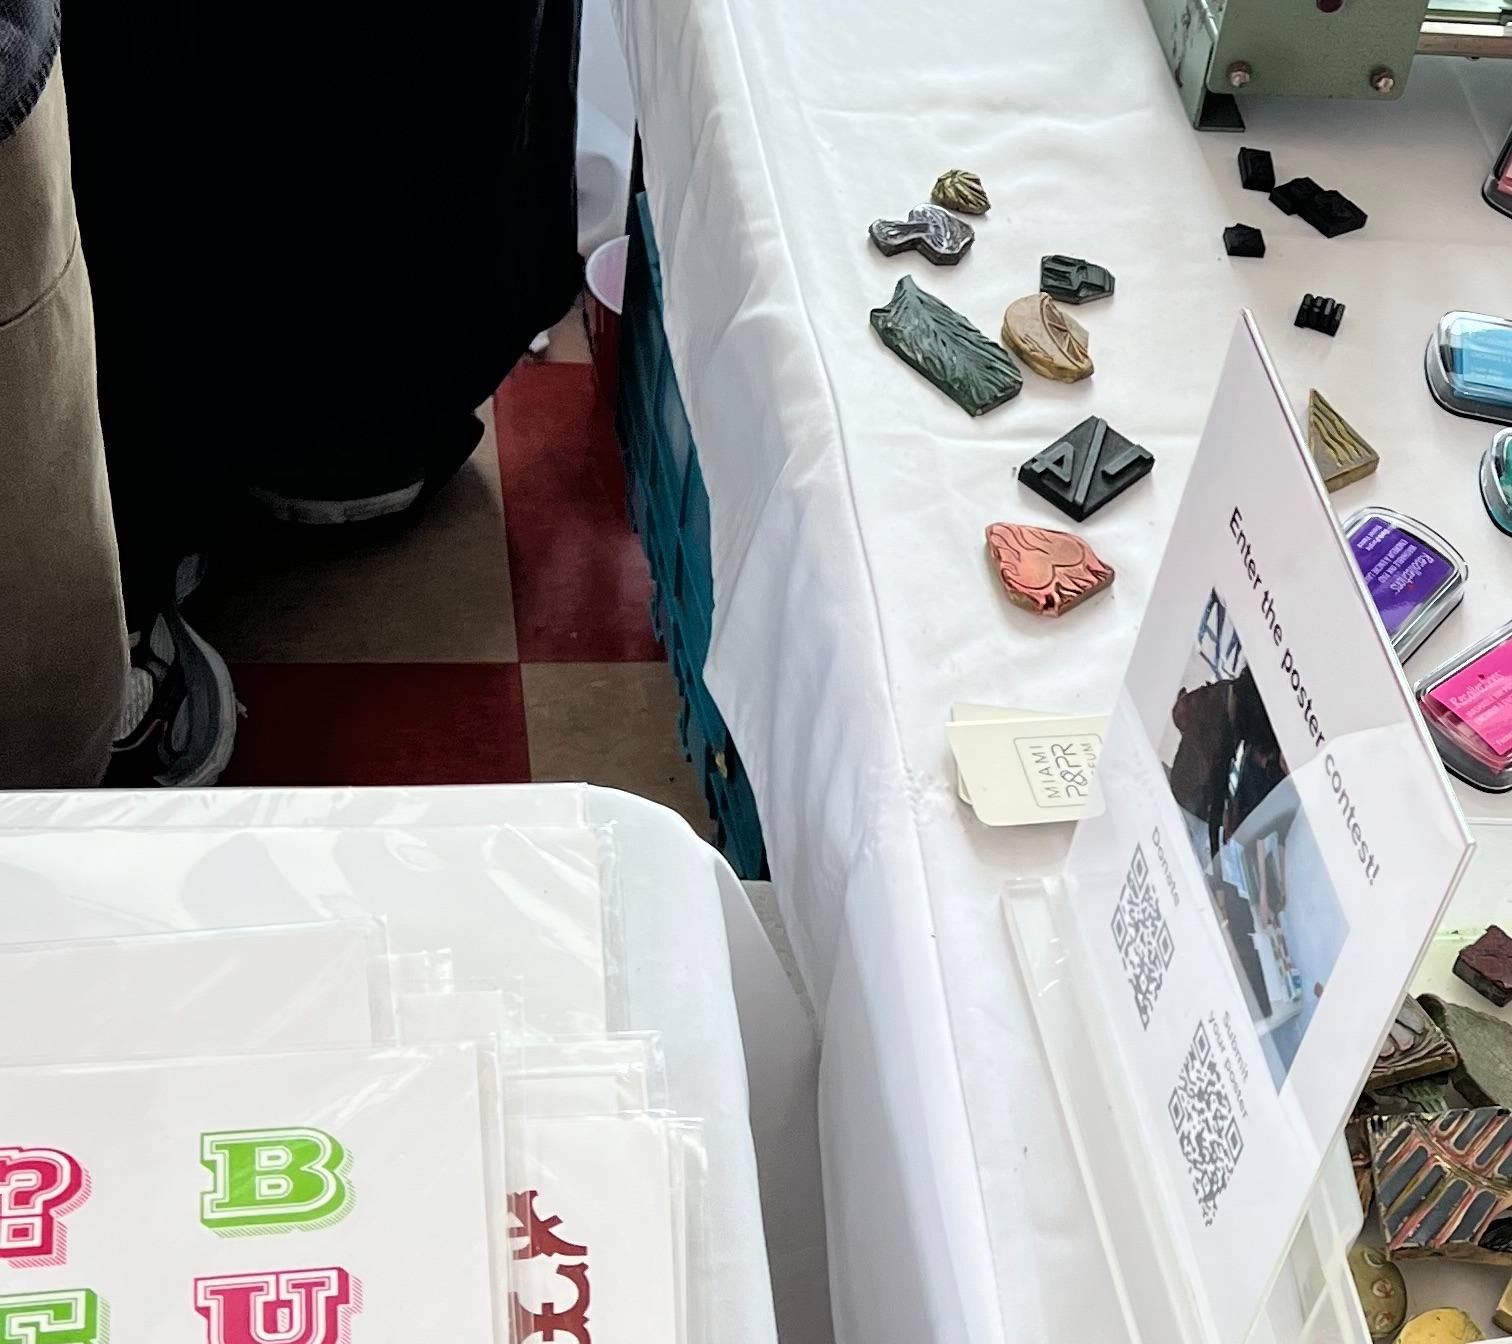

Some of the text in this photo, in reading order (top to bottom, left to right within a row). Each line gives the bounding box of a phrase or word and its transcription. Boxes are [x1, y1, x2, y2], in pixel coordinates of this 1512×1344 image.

[1389, 552, 1434, 594] Recollections
[1230, 507, 1383, 886] Enter the poster contest!
[1449, 670, 1504, 709] Recollections
[1029, 745, 1061, 798] MIAMI
[1152, 827, 1181, 908] Donate
[1206, 1009, 1250, 1119] your poster
[1222, 1011, 1249, 1084] Submit
